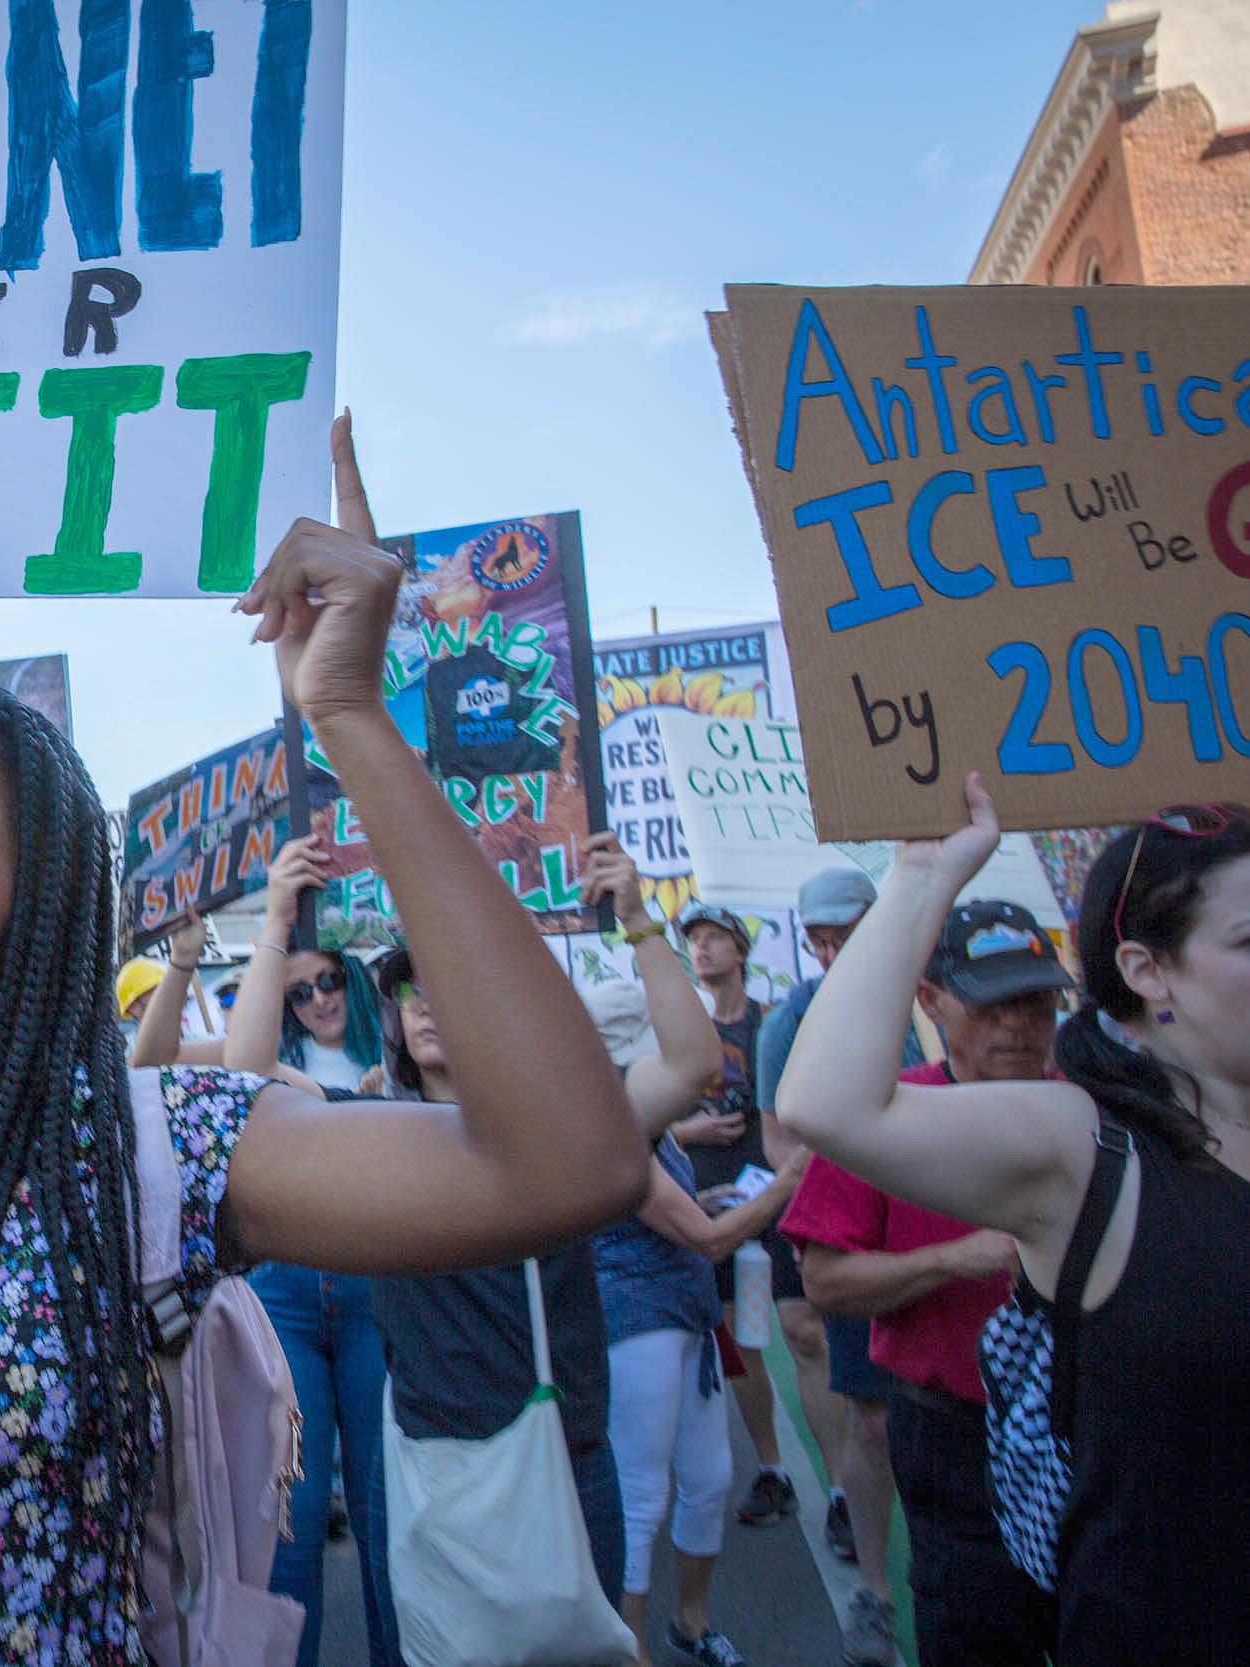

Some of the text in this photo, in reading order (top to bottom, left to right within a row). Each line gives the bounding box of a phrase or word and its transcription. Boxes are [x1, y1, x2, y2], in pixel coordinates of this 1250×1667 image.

[793, 464, 1074, 633] ICE
[1064, 471, 1140, 522] Will
[1126, 520, 1198, 571] Be
[658, 636, 762, 674] JUSTICE
[852, 611, 1250, 786] by 2040
[607, 739, 667, 769] RES
[707, 720, 803, 766] CLI
[687, 765, 807, 799] COMM
[334, 772, 548, 845] ERGY
[141, 820, 276, 930] SWIM
